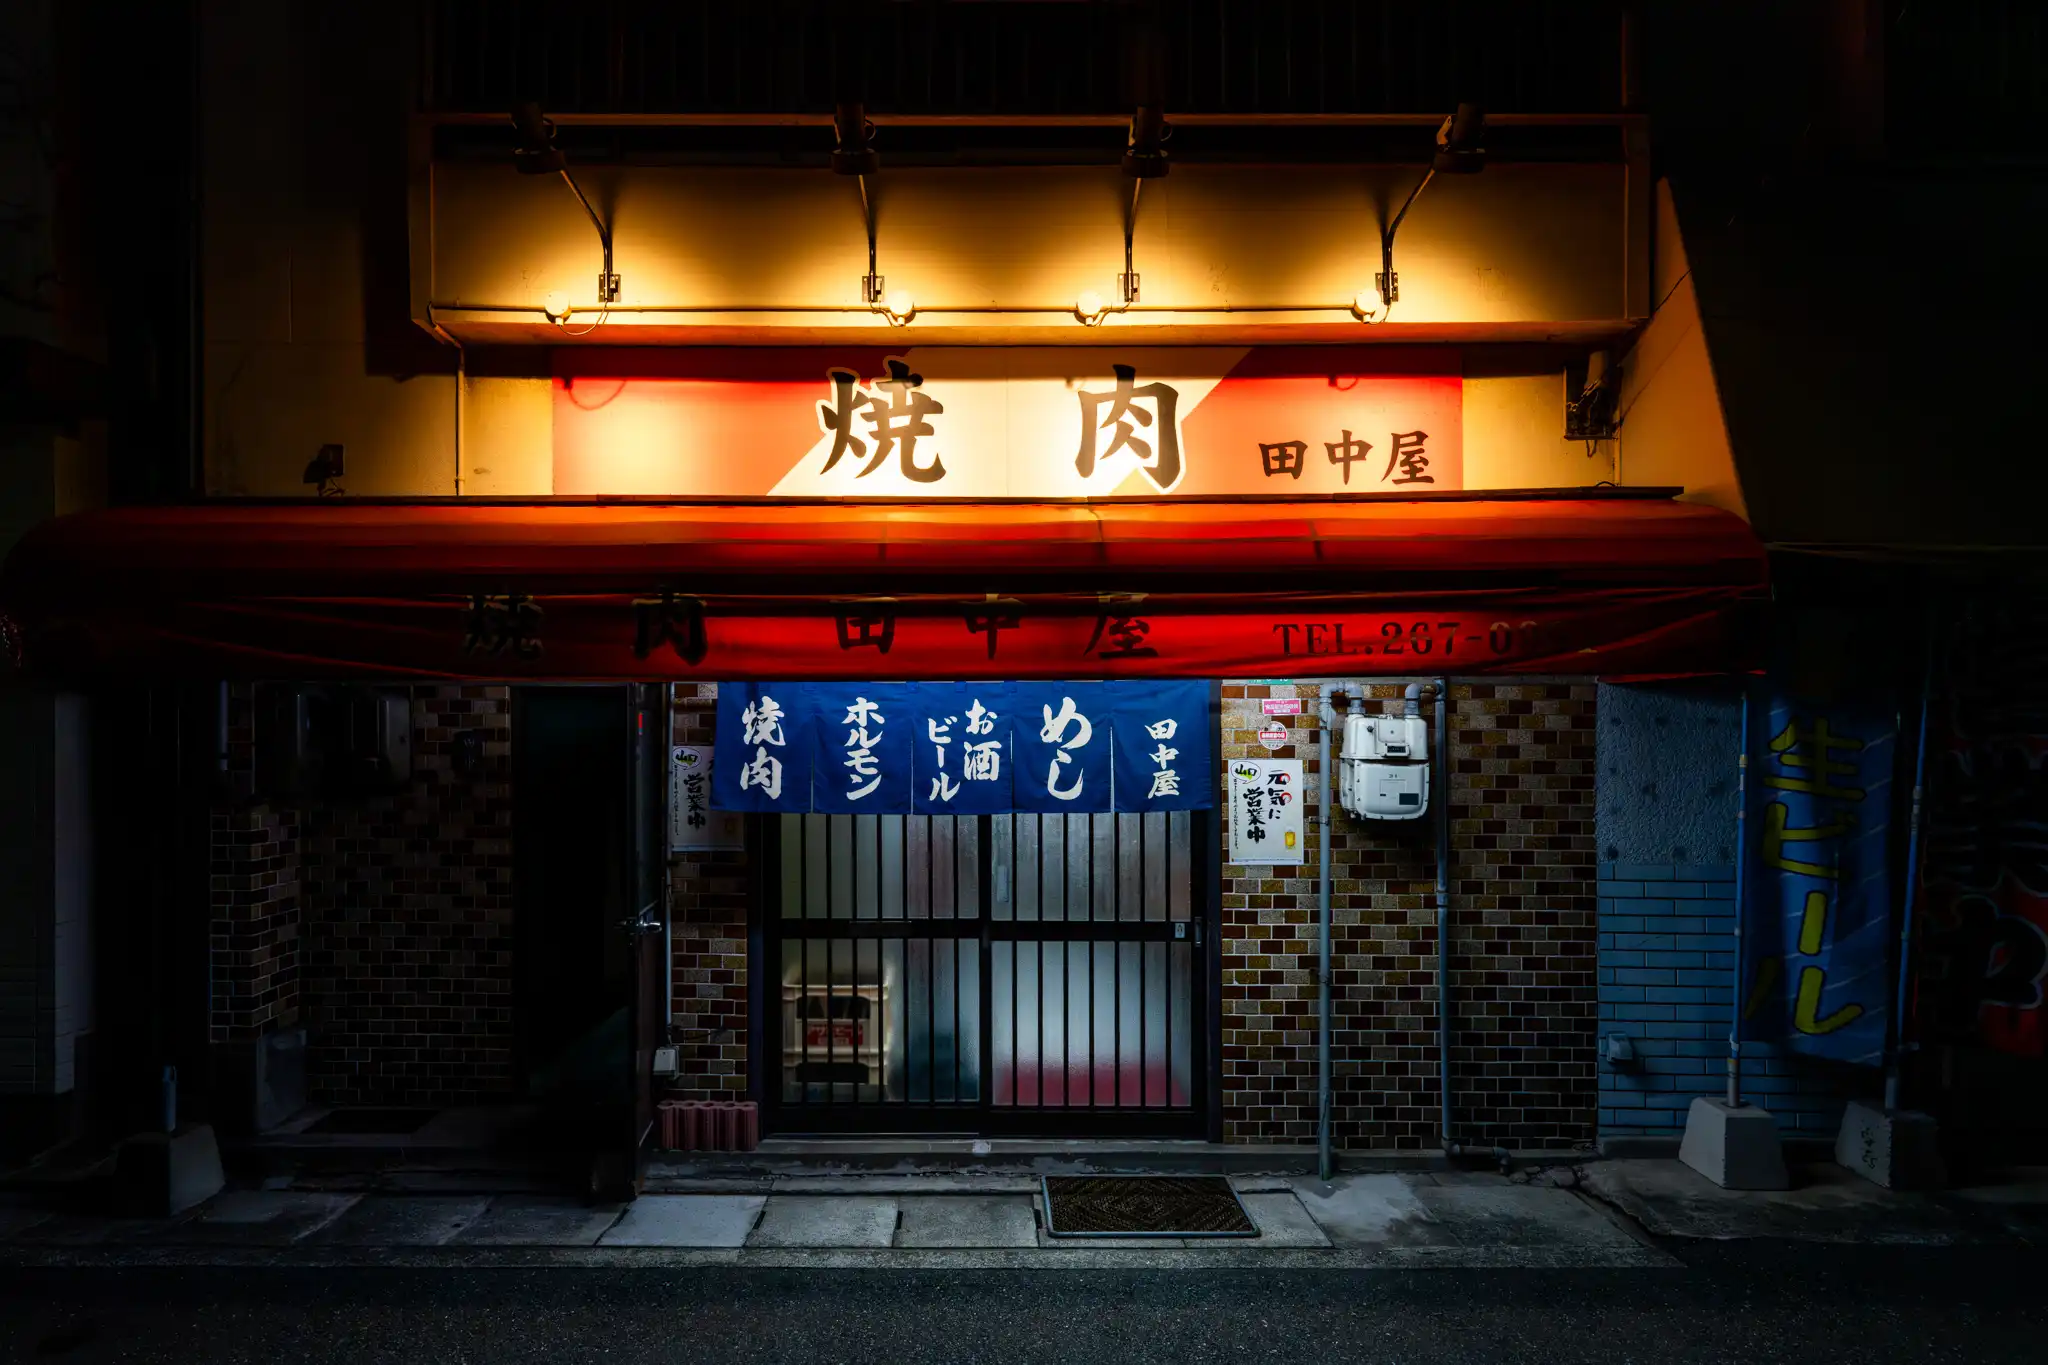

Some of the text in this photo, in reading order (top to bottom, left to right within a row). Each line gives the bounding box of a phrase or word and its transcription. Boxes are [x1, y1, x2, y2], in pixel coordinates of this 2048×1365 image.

[820, 360, 1180, 486] 焼肉
[1258, 430, 1434, 485] 田中屋
[833, 592, 1158, 660] 田中屋
[739, 695, 786, 800] 焼肉
[841, 697, 885, 800] ホルモン
[927, 715, 961, 802] ビール
[963, 698, 1002, 782] お酒
[1041, 696, 1093, 800] めし
[1144, 718, 1181, 799] 田中屋
[1243, 787, 1266, 844] 営業中
[1267, 770, 1292, 819] 元気に
[1742, 715, 1866, 1035] 生ビール
